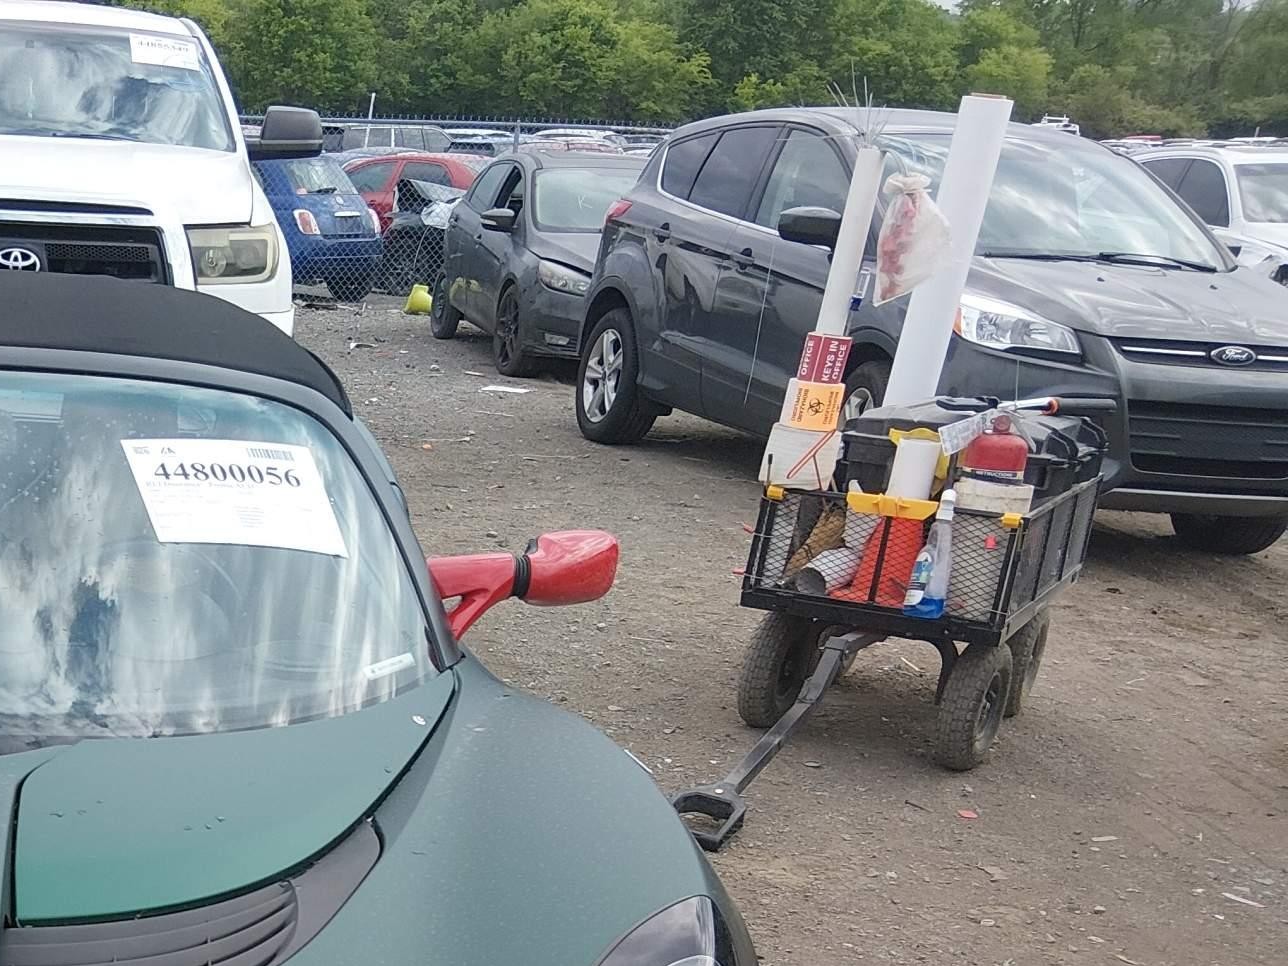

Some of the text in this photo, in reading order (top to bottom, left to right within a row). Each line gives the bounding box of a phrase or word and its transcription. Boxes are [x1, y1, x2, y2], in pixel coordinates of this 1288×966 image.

[801, 340, 814, 375] OFFICE
[821, 341, 839, 381] KEYS IN
[832, 344, 847, 380] OFFICE
[1222, 348, 1248, 360] Ford
[154, 462, 301, 488] 44800056
